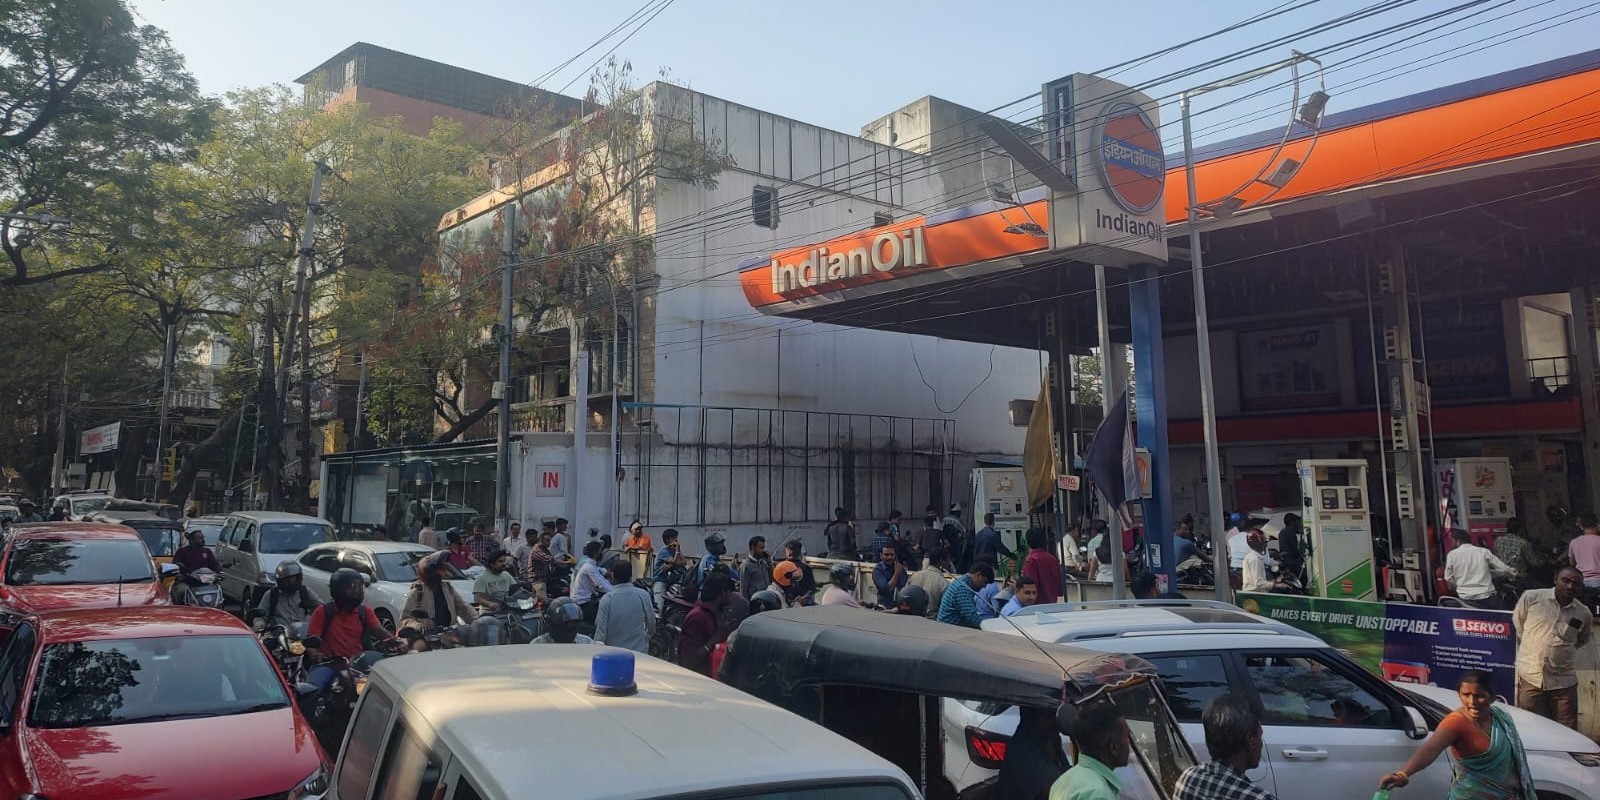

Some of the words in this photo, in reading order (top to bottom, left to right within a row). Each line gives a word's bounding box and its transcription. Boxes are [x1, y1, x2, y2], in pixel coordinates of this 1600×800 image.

[1096, 208, 1162, 243] IndianOil
[772, 226, 928, 294] IndianOil
[543, 471, 559, 488] IN
[1271, 608, 1299, 620] MAKES
[1301, 611, 1327, 622] EVERY
[1328, 612, 1354, 625] DRIVE
[1355, 615, 1440, 636] UNSTOPPABLE.
[1466, 621, 1505, 634] SERVO
